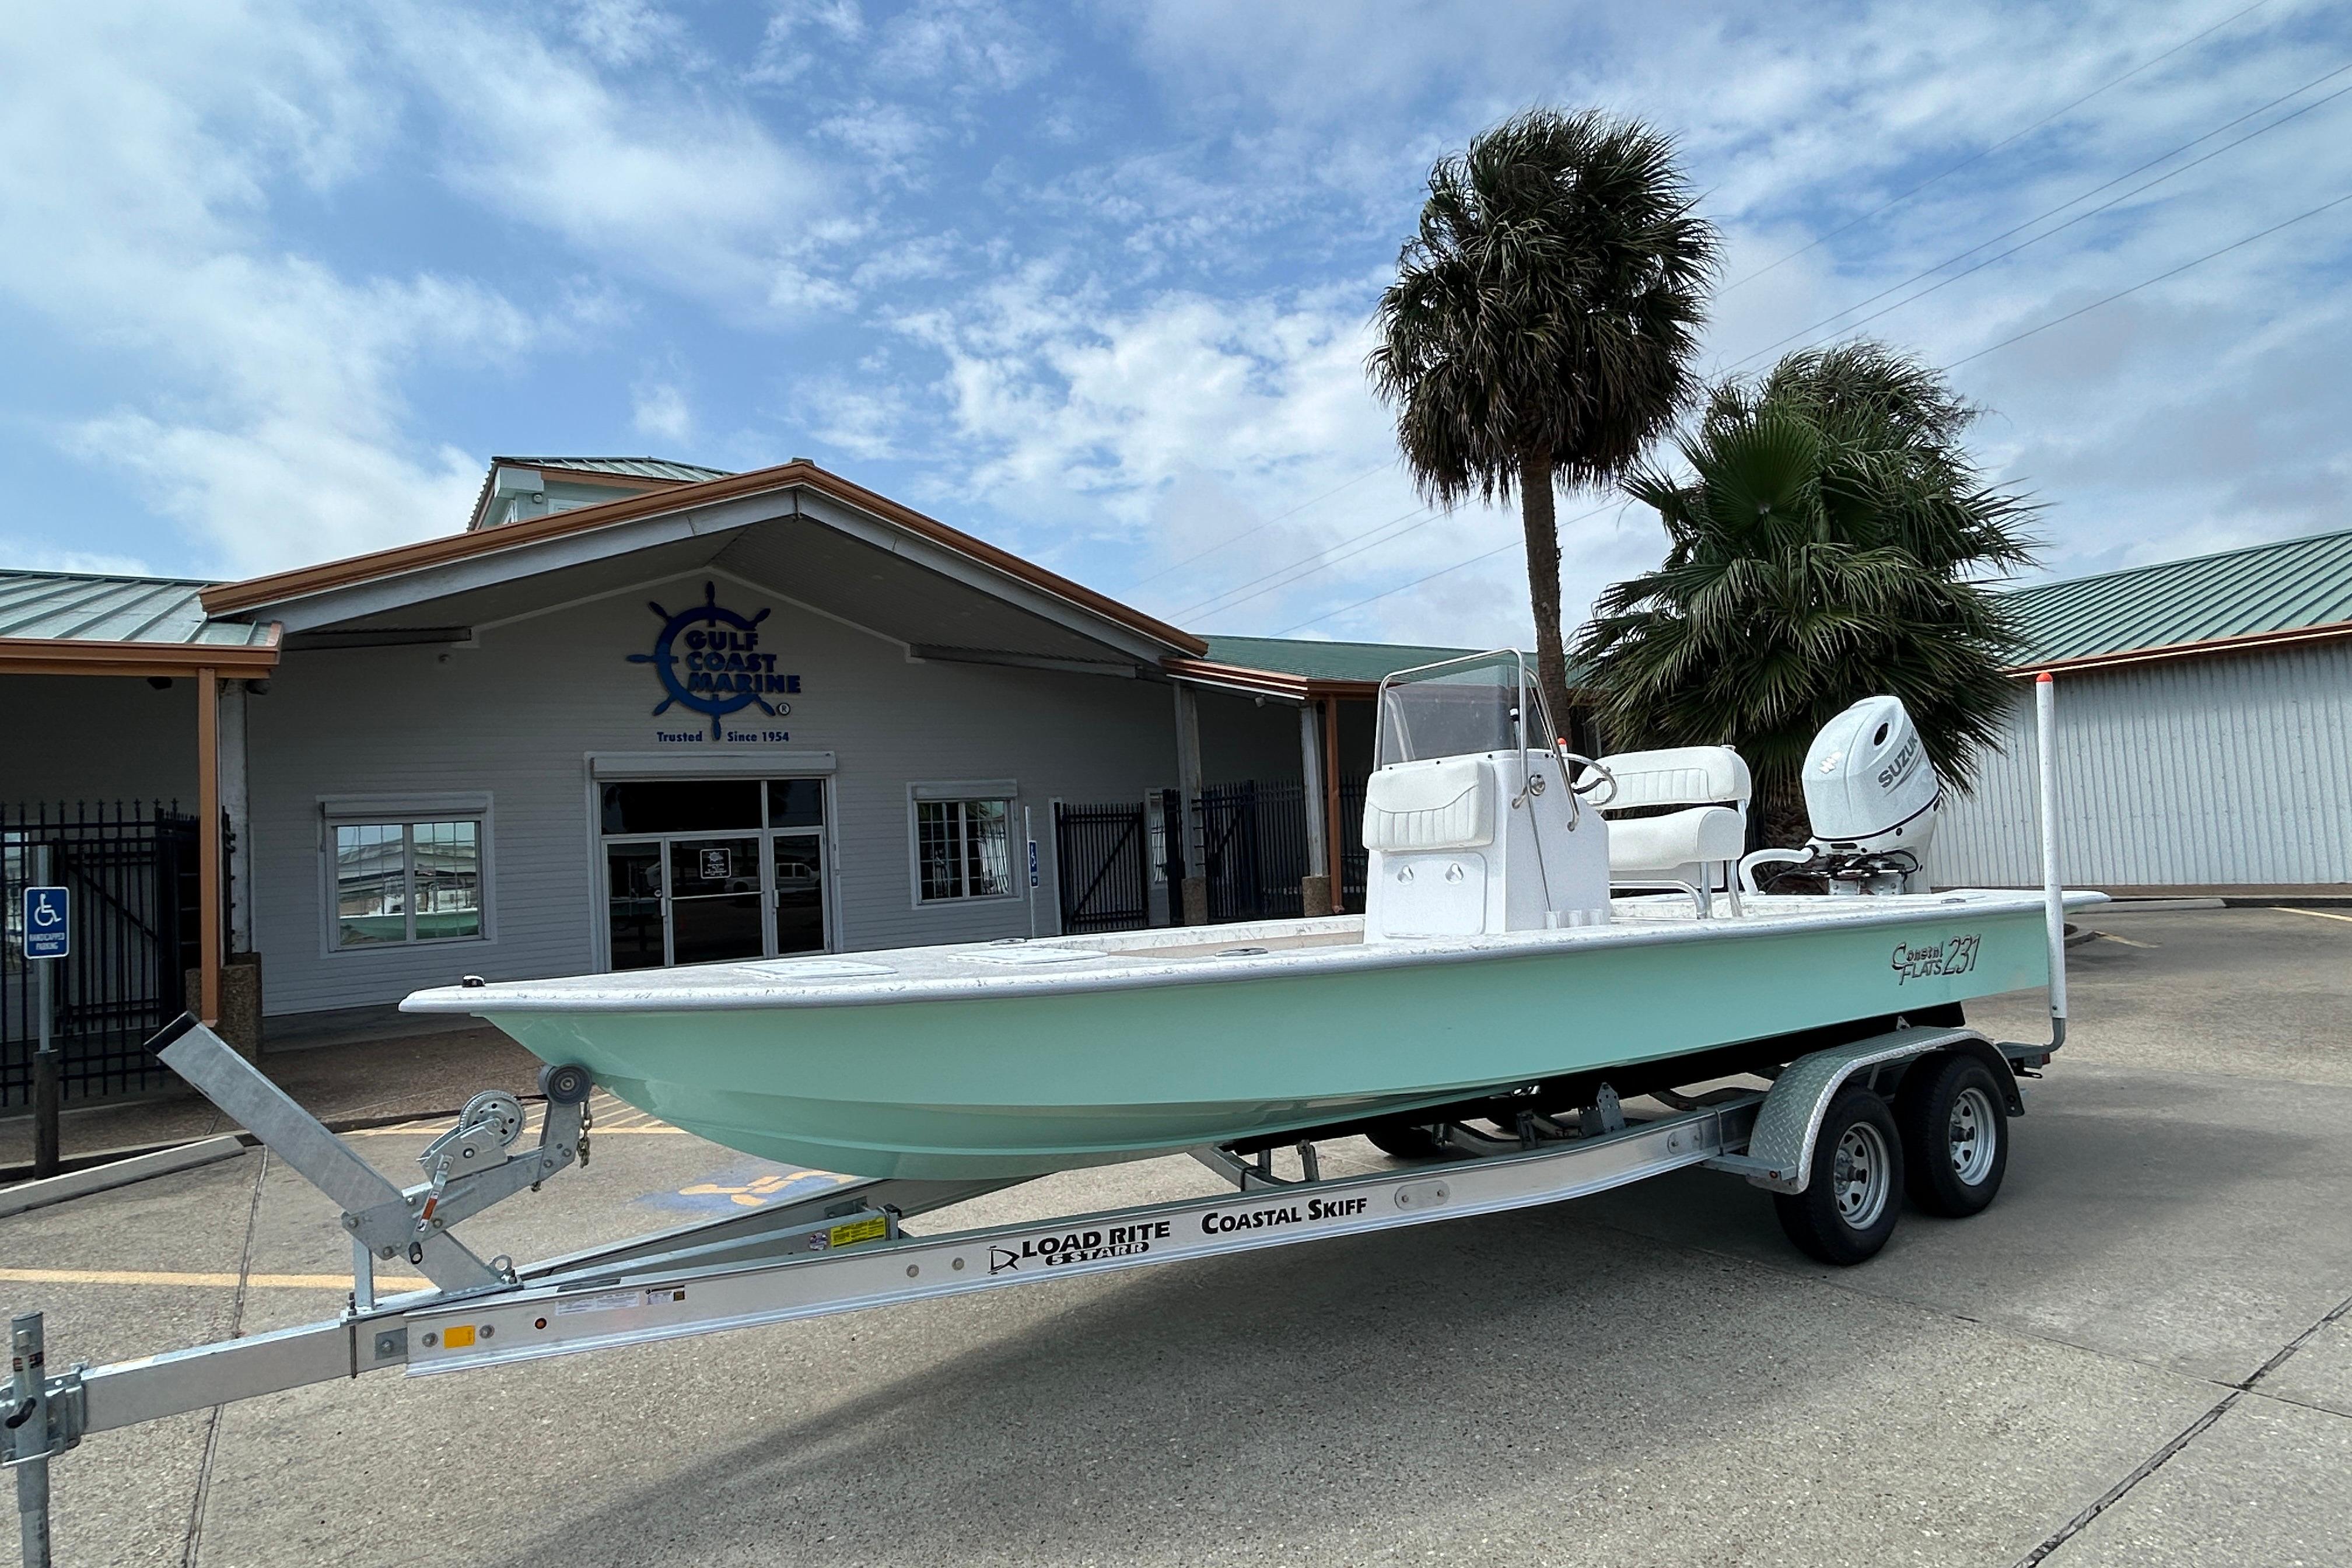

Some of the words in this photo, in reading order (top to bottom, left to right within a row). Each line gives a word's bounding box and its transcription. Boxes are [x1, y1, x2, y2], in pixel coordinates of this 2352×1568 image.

[685, 630, 758, 650] GULF
[685, 652, 777, 673] COAST
[687, 672, 802, 693] MARINE
[656, 730, 703, 743] Trusted
[727, 730, 758, 743] Since
[762, 731, 790, 743] 1954
[1878, 727, 1920, 788] SUZUK
[1891, 941, 1944, 971] Coastal
[1899, 958, 1943, 986] FLATS
[1021, 1230, 1101, 1259] LOAD
[1109, 1220, 1171, 1245] RITE
[1050, 1254, 1065, 1266] 5
[1070, 1241, 1147, 1264] STARR
